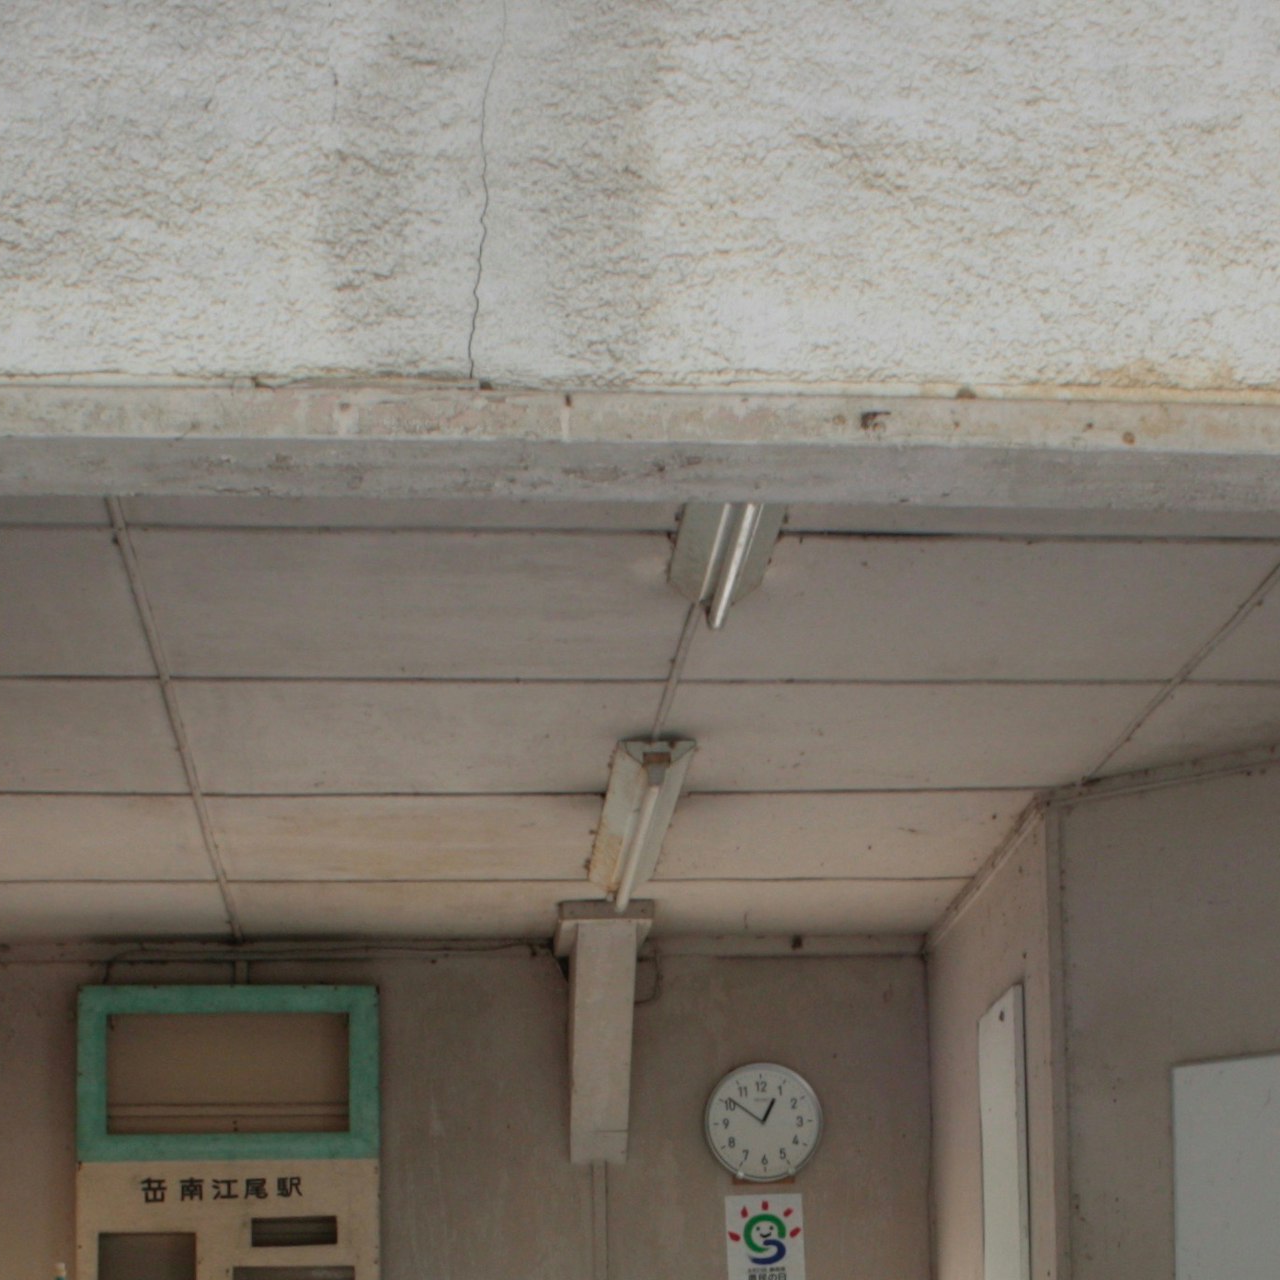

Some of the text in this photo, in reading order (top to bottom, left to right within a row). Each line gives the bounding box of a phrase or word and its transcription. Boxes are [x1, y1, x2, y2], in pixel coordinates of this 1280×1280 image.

[738, 1086, 749, 1097] 11
[755, 1081, 767, 1093] 12
[777, 1085, 783, 1096] 1
[725, 1099, 737, 1112] 10
[790, 1098, 798, 1110] 2
[722, 1118, 730, 1130] 9
[796, 1115, 804, 1127] 3
[727, 1137, 736, 1149] 8
[792, 1135, 800, 1147] 4
[742, 1149, 750, 1161] 7
[761, 1153, 769, 1165] 6
[779, 1148, 786, 1160] 5
[140, 1176, 304, 1204] 岳南江尾駅
